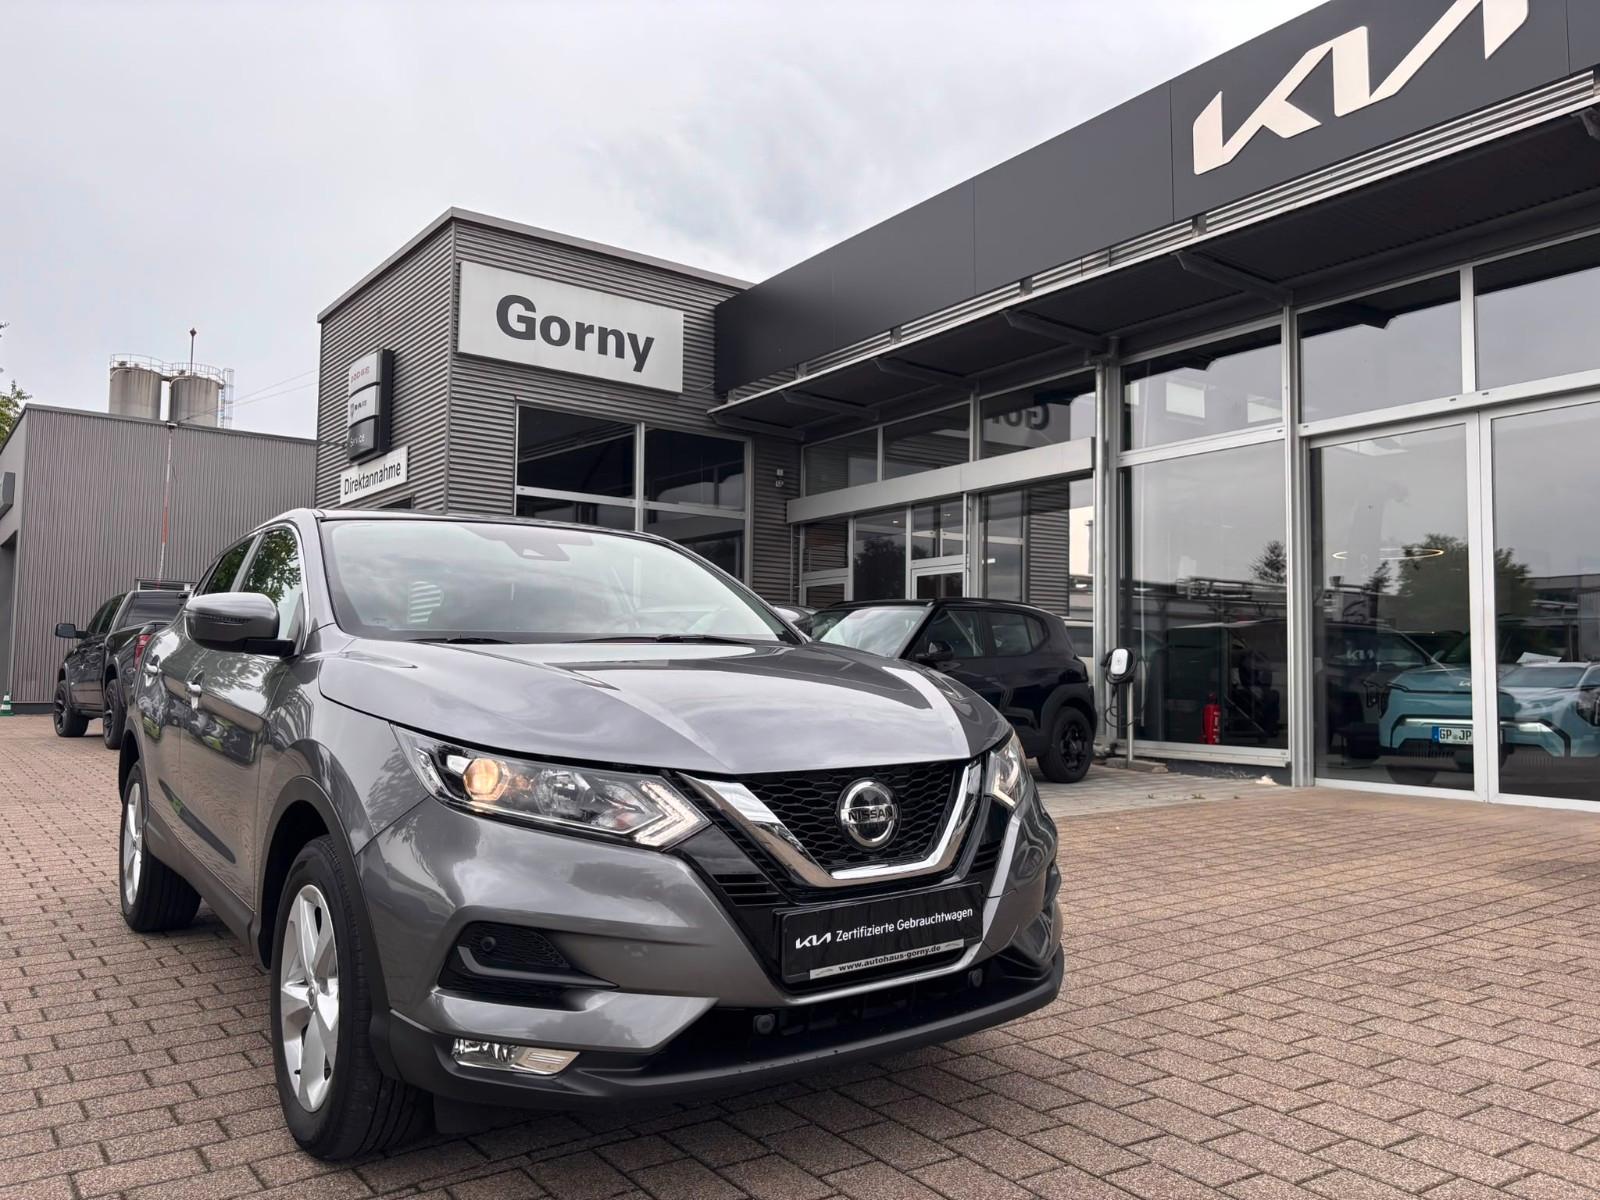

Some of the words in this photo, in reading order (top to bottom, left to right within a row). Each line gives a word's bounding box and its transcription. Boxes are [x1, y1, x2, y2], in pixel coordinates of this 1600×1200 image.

[496, 294, 655, 373] Gorny
[344, 462, 401, 495] Direktannahme
[1439, 728, 1453, 740] GP
[848, 805, 893, 822] NISSAN
[795, 932, 832, 949] KIA
[836, 923, 895, 942] Zertifizierte
[896, 908, 973, 932] Gebrauchtwagen
[838, 945, 942, 972] www.autohaus-gorny.de
